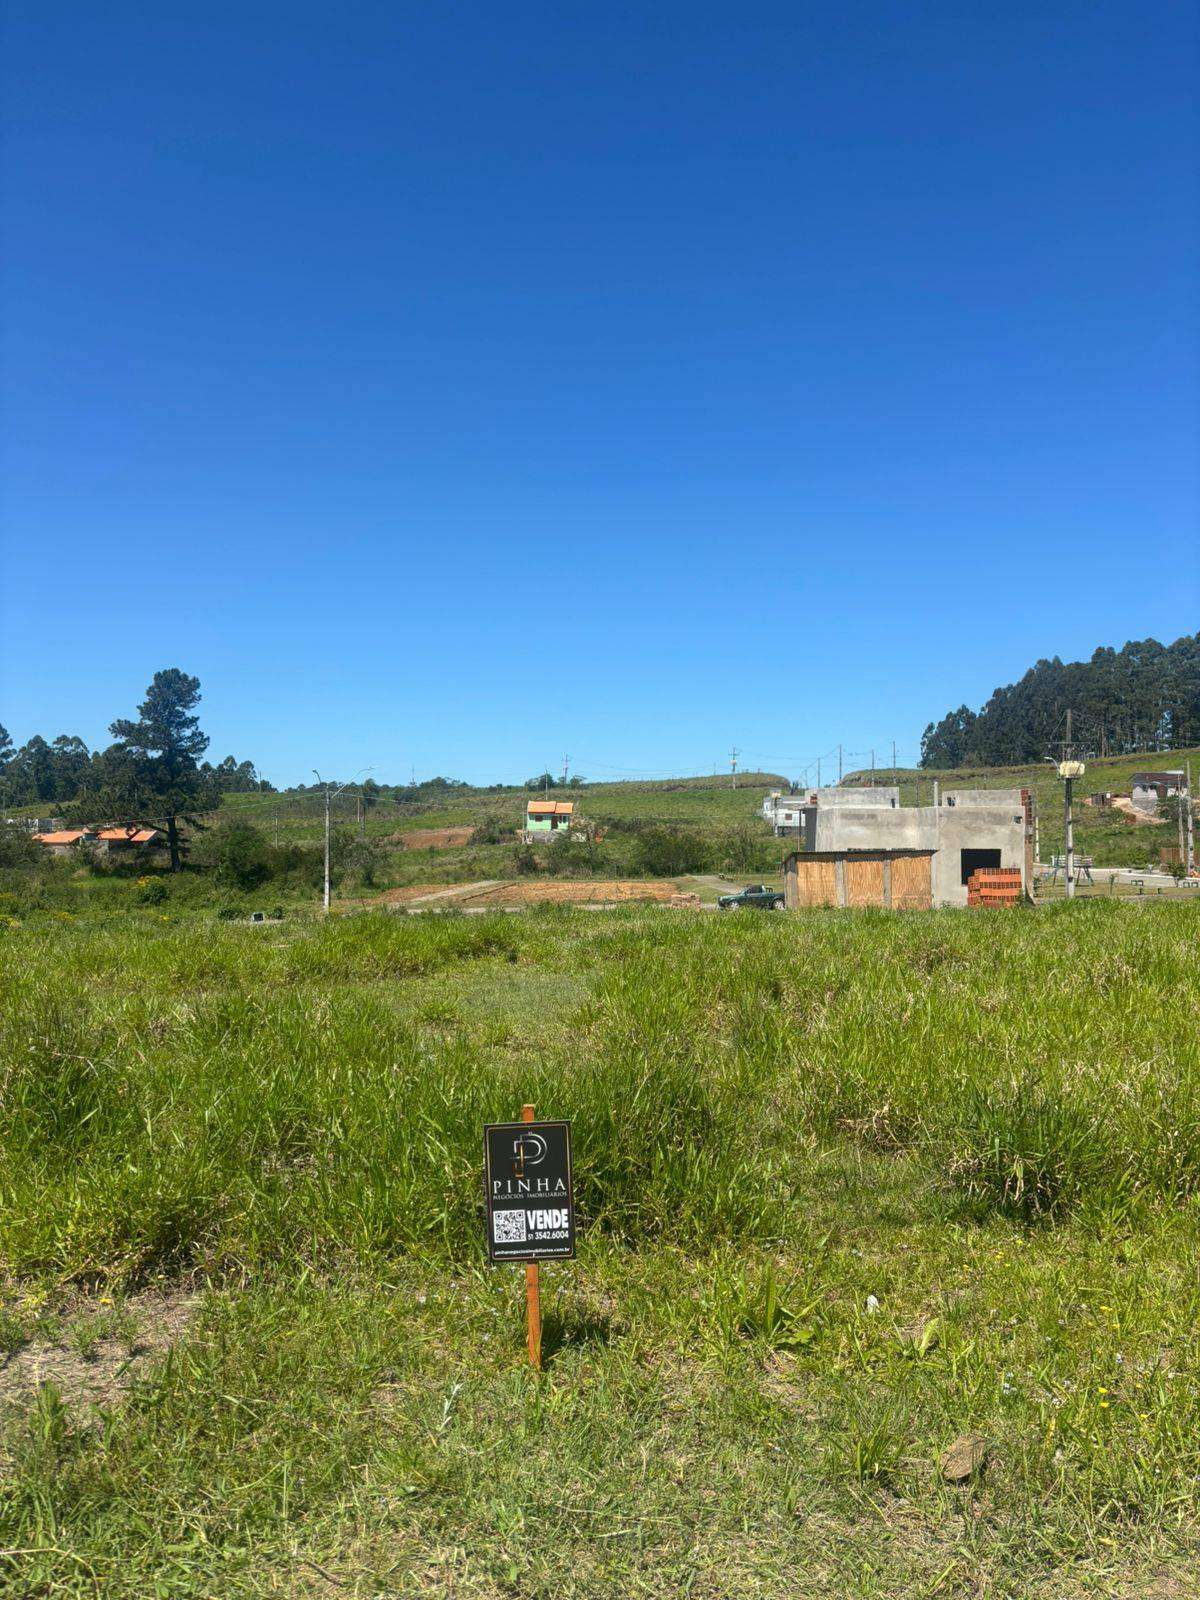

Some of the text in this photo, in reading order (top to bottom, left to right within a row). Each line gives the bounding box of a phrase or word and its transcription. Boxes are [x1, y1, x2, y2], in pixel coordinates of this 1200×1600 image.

[493, 1178, 566, 1194] PINHA
[526, 1208, 569, 1230] VENDE
[534, 1230, 569, 1240] 3542.6004
